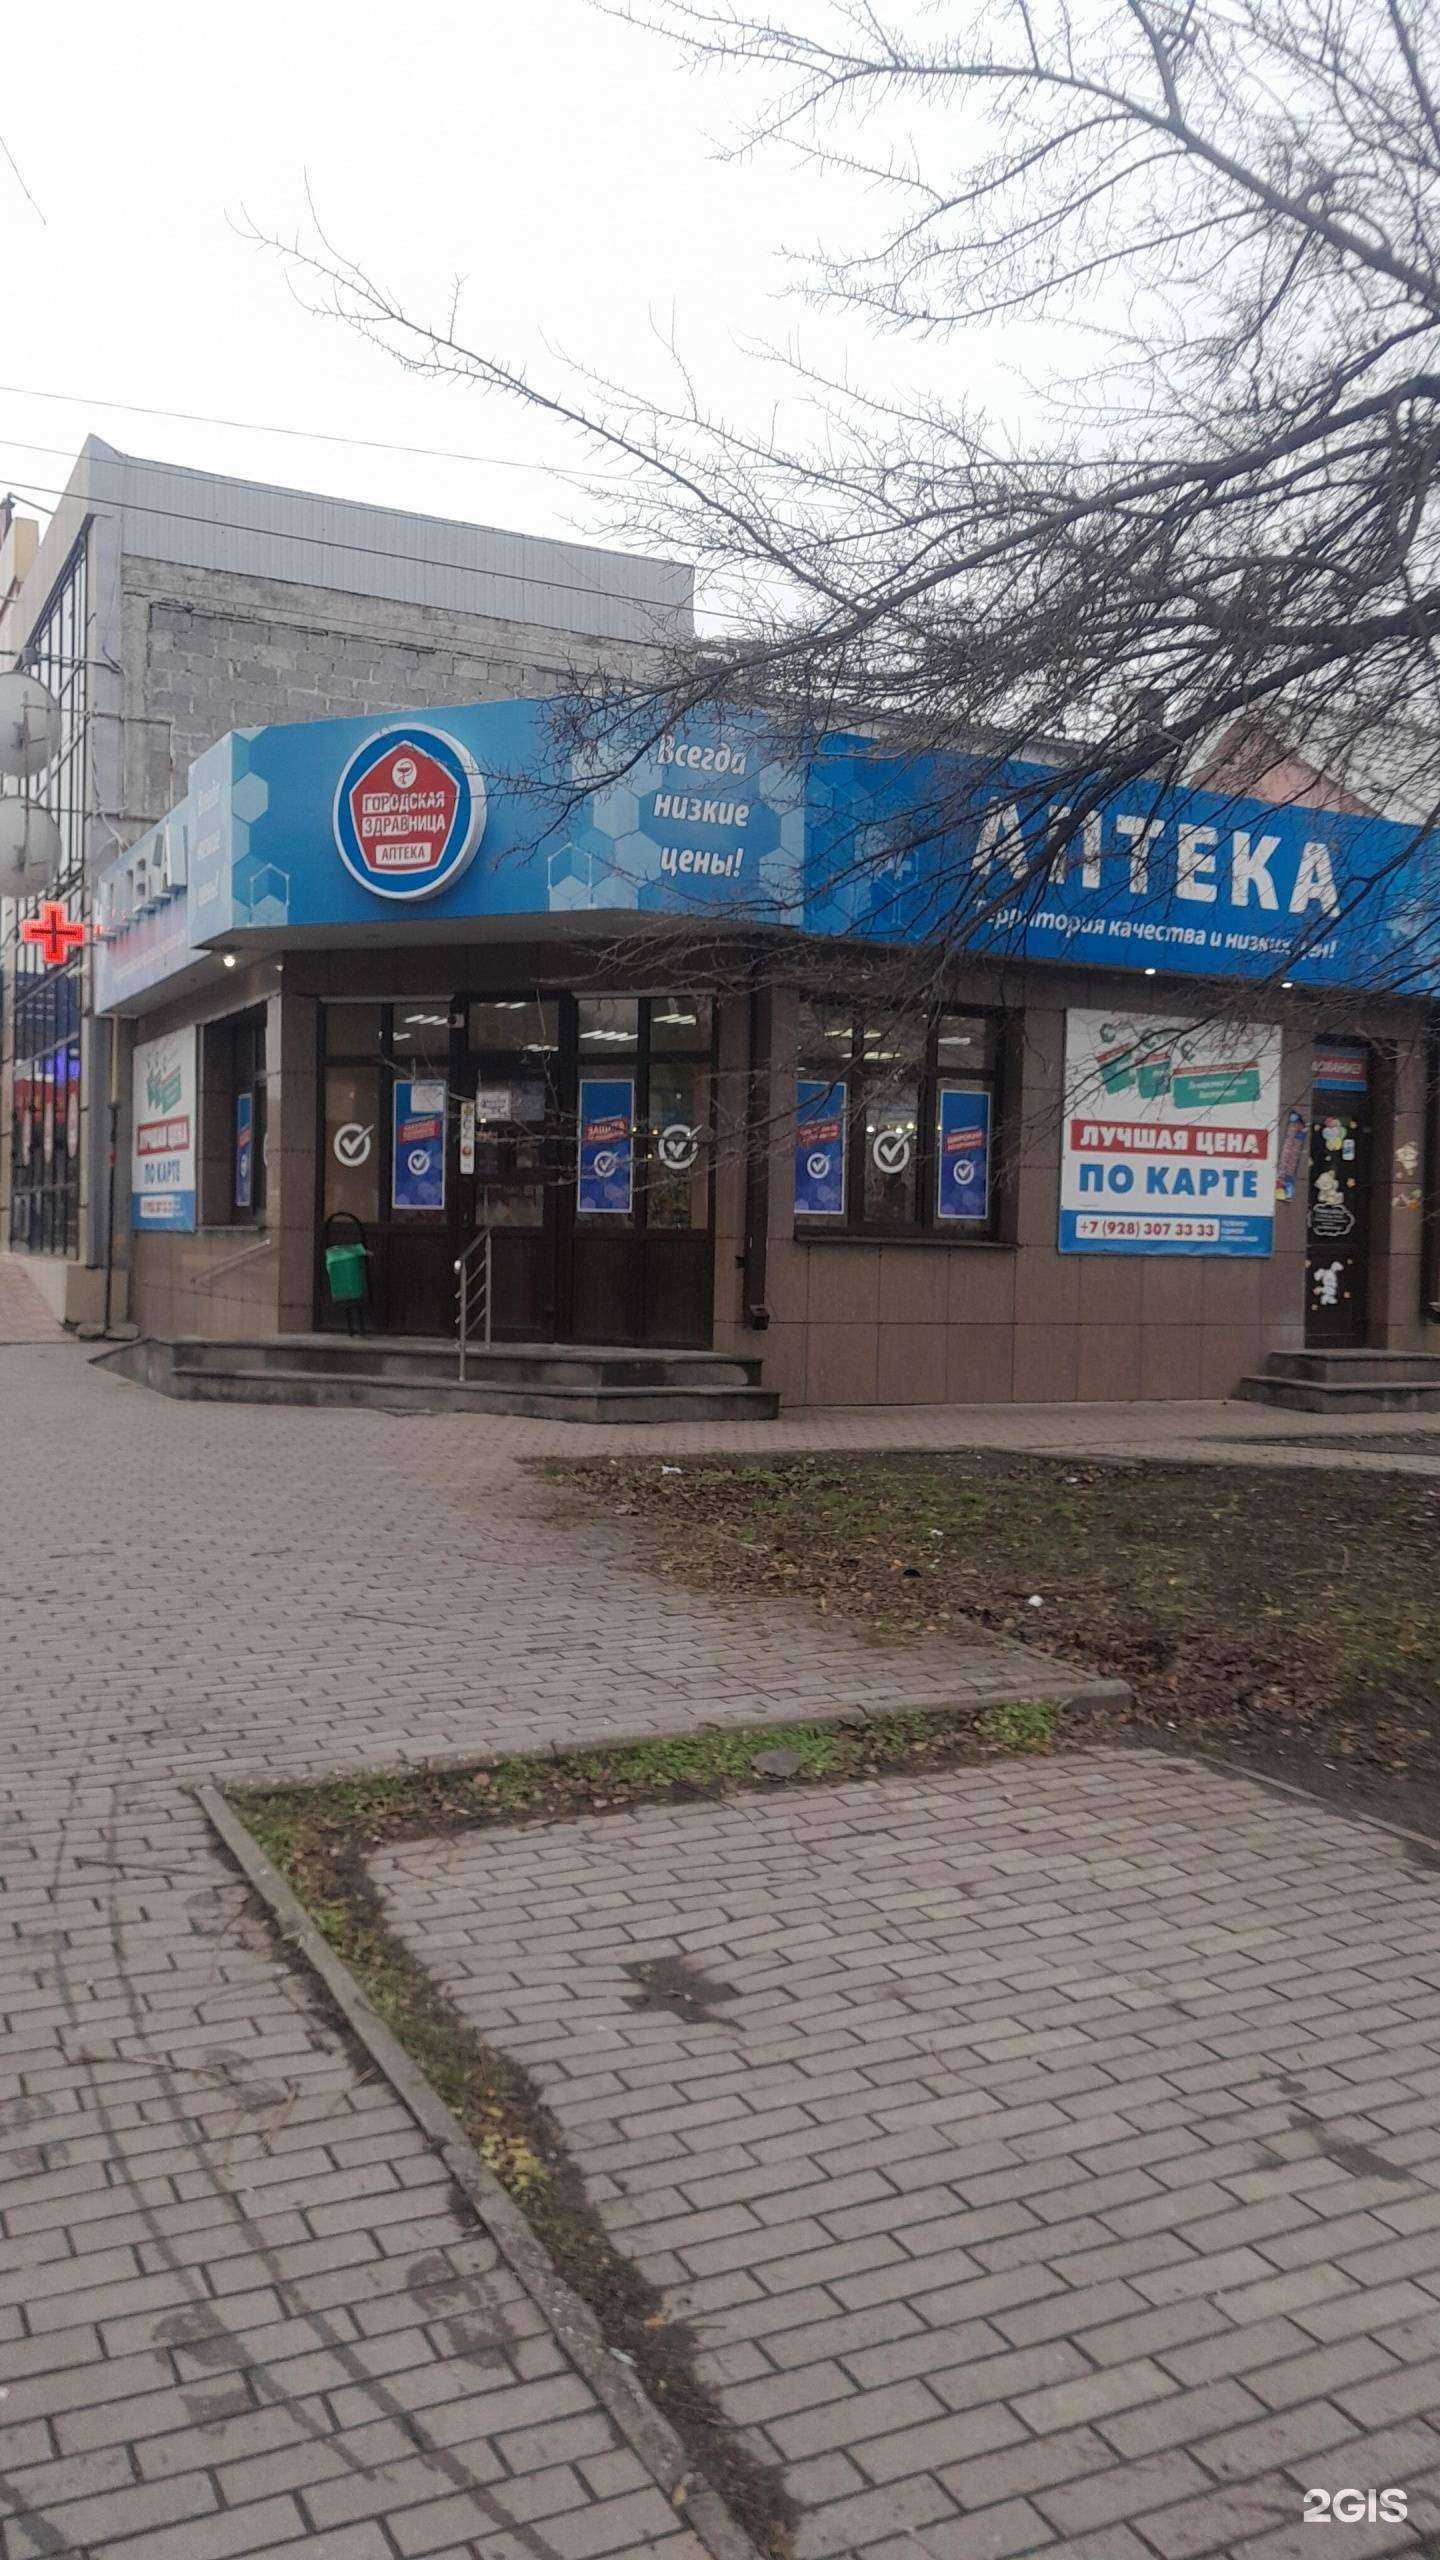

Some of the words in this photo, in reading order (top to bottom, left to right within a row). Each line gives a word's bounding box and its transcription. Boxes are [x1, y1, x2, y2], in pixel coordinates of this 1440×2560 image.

[657, 734, 747, 775] Всегда
[363, 790, 446, 814] ГОРОДСКАЯ
[653, 793, 750, 827] низкие
[363, 813, 446, 837] ЗДРАВНИЦА
[381, 845, 426, 862] АПТЕКА
[660, 847, 744, 878] цены!
[969, 796, 1341, 918] АПТЕКА
[973, 898, 1105, 938] рртория
[1108, 919, 1207, 946] качества
[1210, 931, 1222, 947] и
[1080, 1125, 1189, 1151] ЛУЧШАЯ
[1196, 1130, 1260, 1155] ЦЕНА
[1079, 1163, 1134, 1194] ПО
[1146, 1166, 1258, 1198] КАРТЕ
[1080, 1220, 1098, 1234] +7
[1102, 1220, 1140, 1238] (928)
[1144, 1221, 1170, 1236] 307
[1175, 1222, 1193, 1237] 33
[1197, 1223, 1214, 1238] 33
